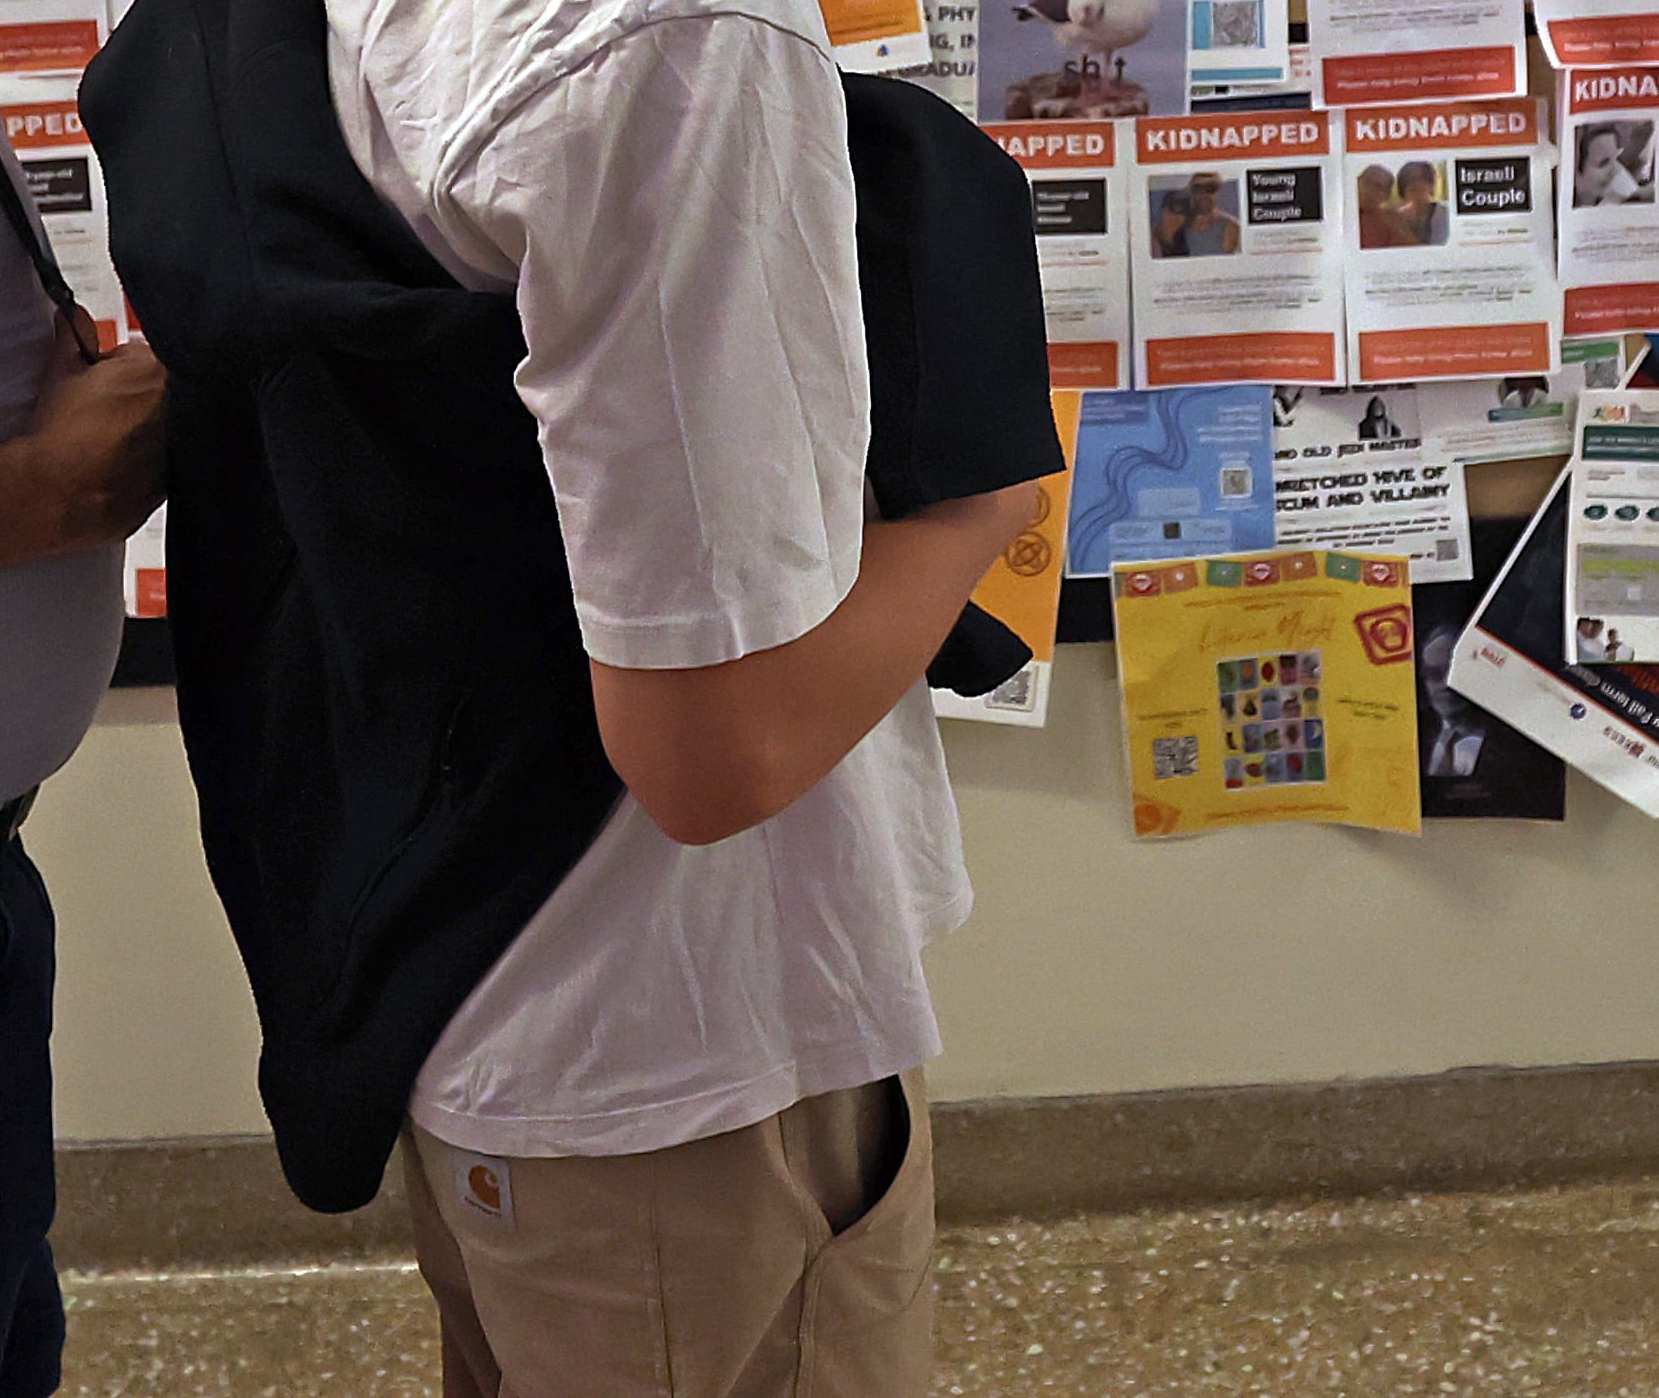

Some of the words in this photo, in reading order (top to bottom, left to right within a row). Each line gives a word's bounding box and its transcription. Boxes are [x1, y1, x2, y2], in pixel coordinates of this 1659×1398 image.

[1355, 111, 1527, 143] KIDNAPPED
[1146, 121, 1319, 153] KIDNAPPED
[1252, 173, 1297, 188] Young
[1459, 166, 1516, 184] Israeli
[1462, 187, 1526, 207] Couple
[1252, 205, 1302, 222] Couple
[1373, 468, 1415, 484] HIVE
[1422, 466, 1447, 479] OF
[1326, 492, 1364, 508] AND
